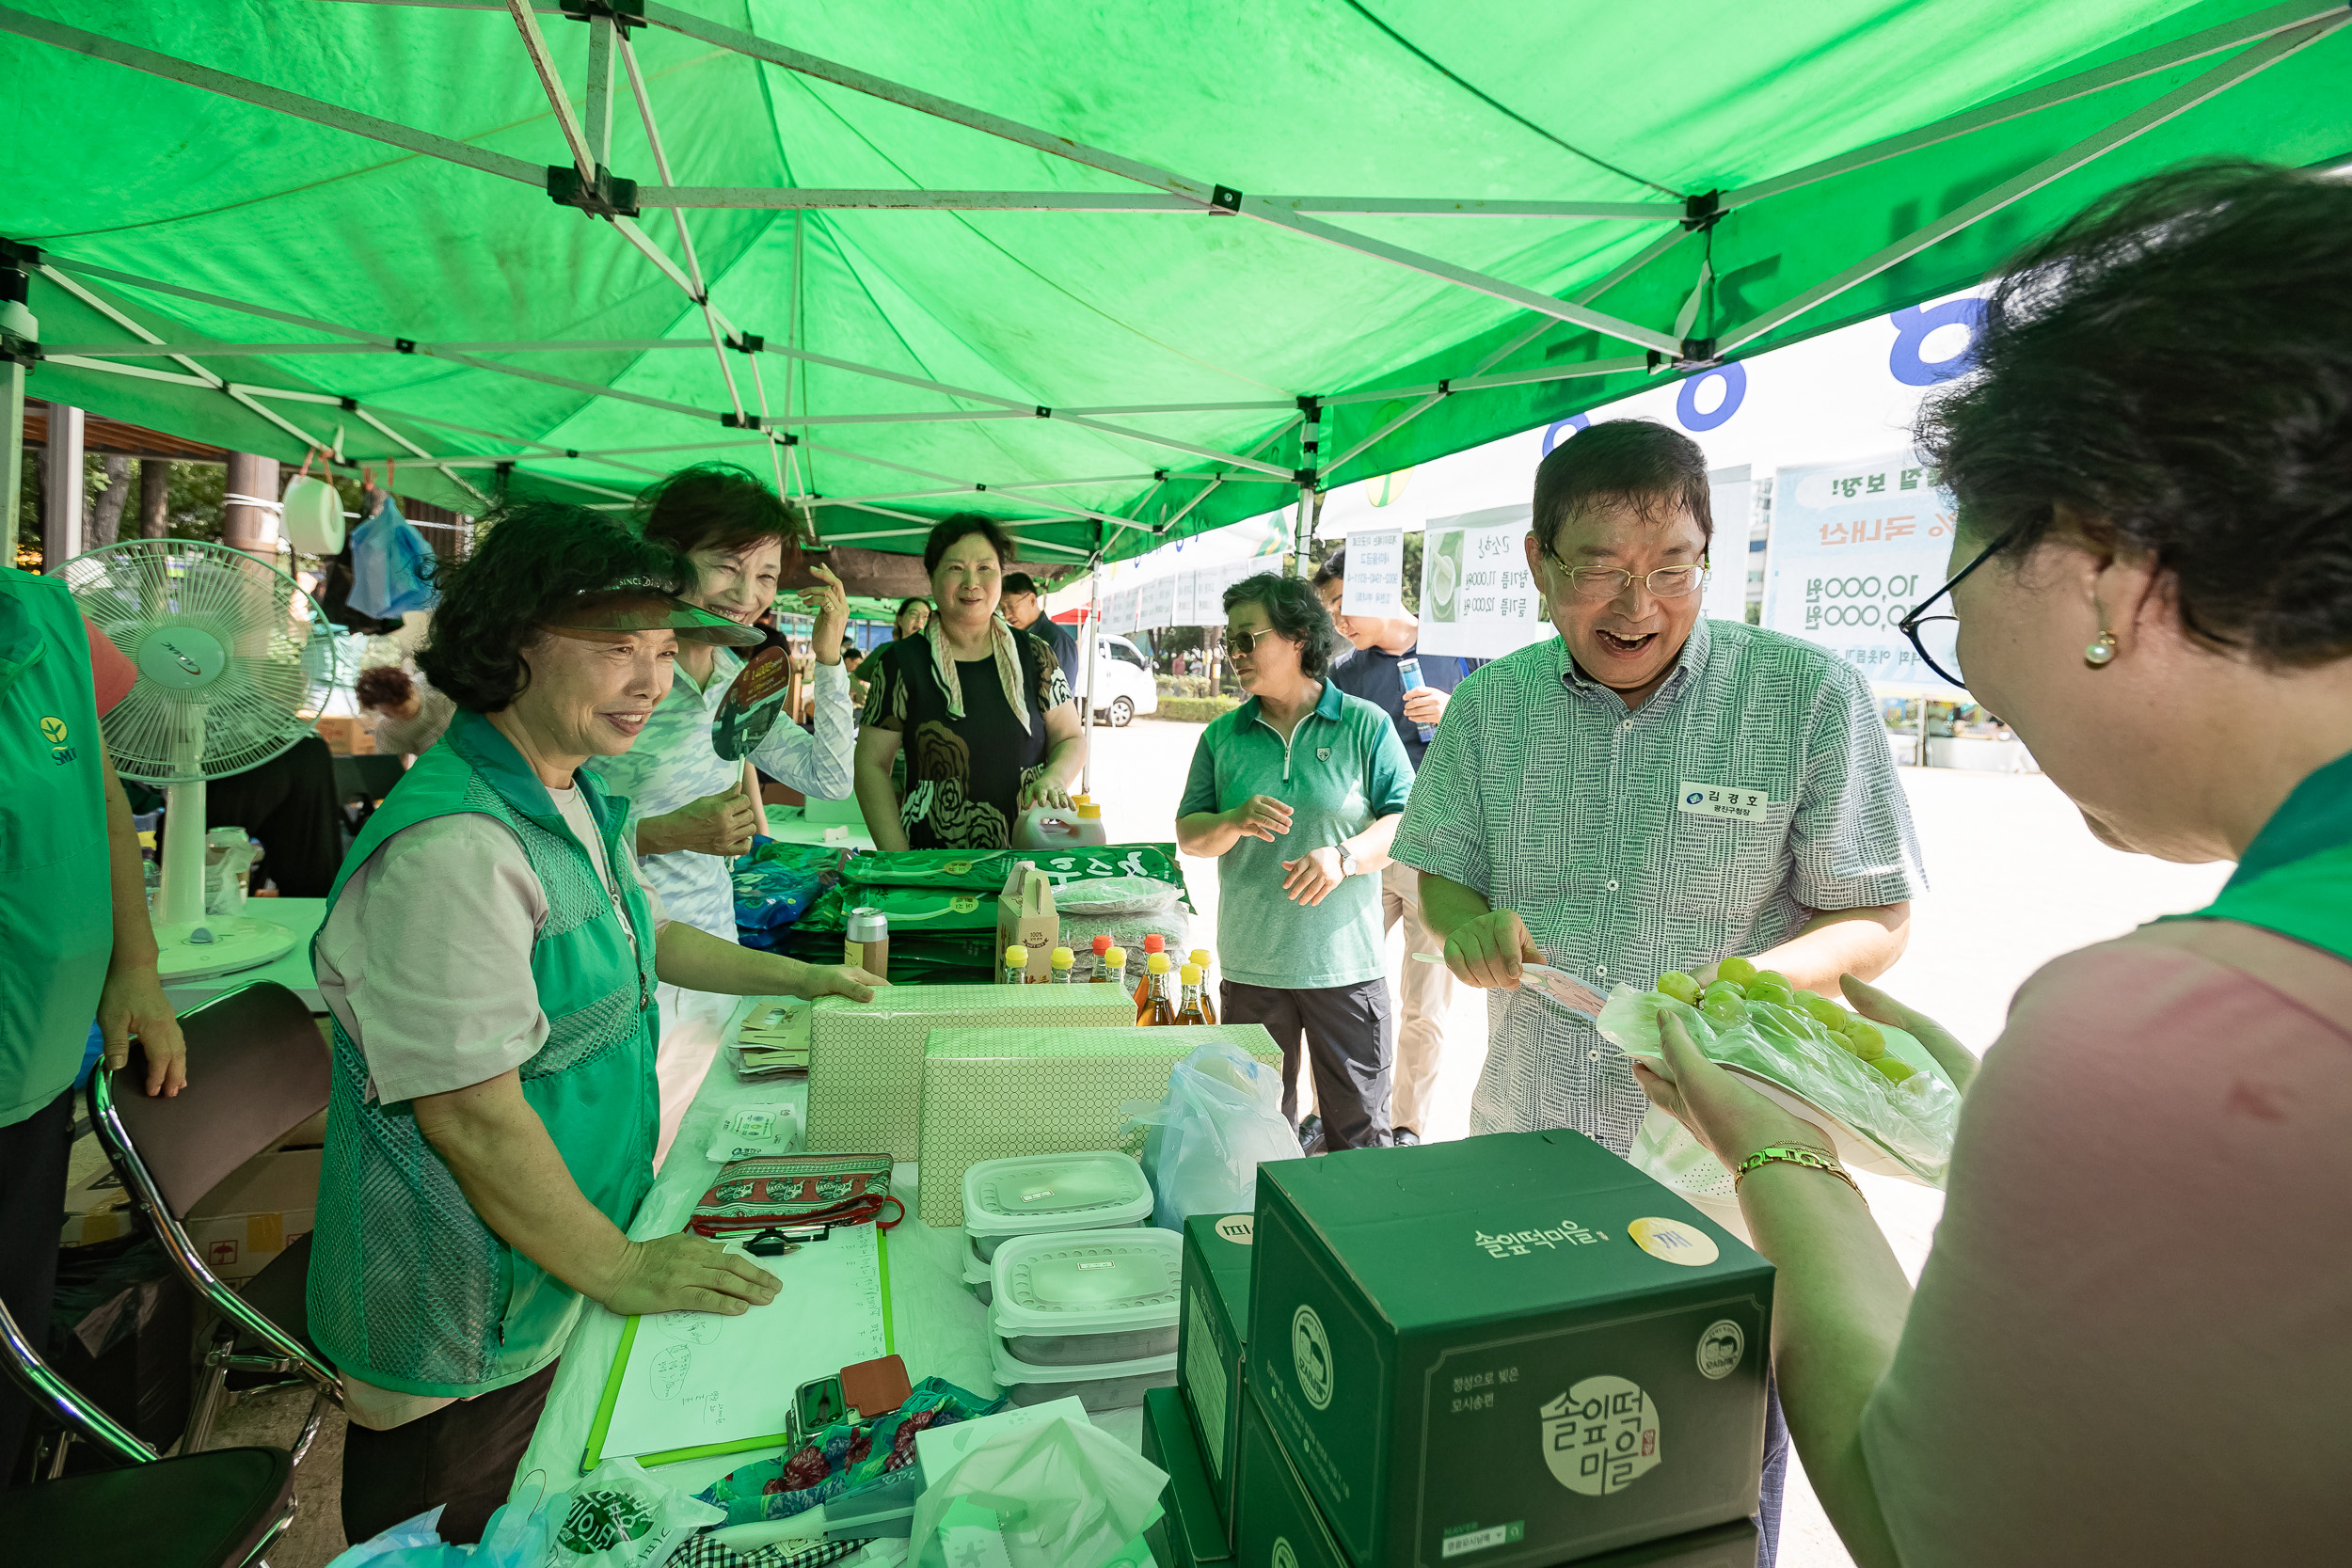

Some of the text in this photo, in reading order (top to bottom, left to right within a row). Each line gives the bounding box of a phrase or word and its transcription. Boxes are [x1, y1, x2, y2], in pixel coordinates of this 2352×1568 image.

[1713, 804, 1751, 816] 광진구청장
[1474, 1219, 1598, 1259] 솔잎떡마을
[1652, 1230, 1693, 1250] 깨
[1450, 1392, 1495, 1413] 모시송편
